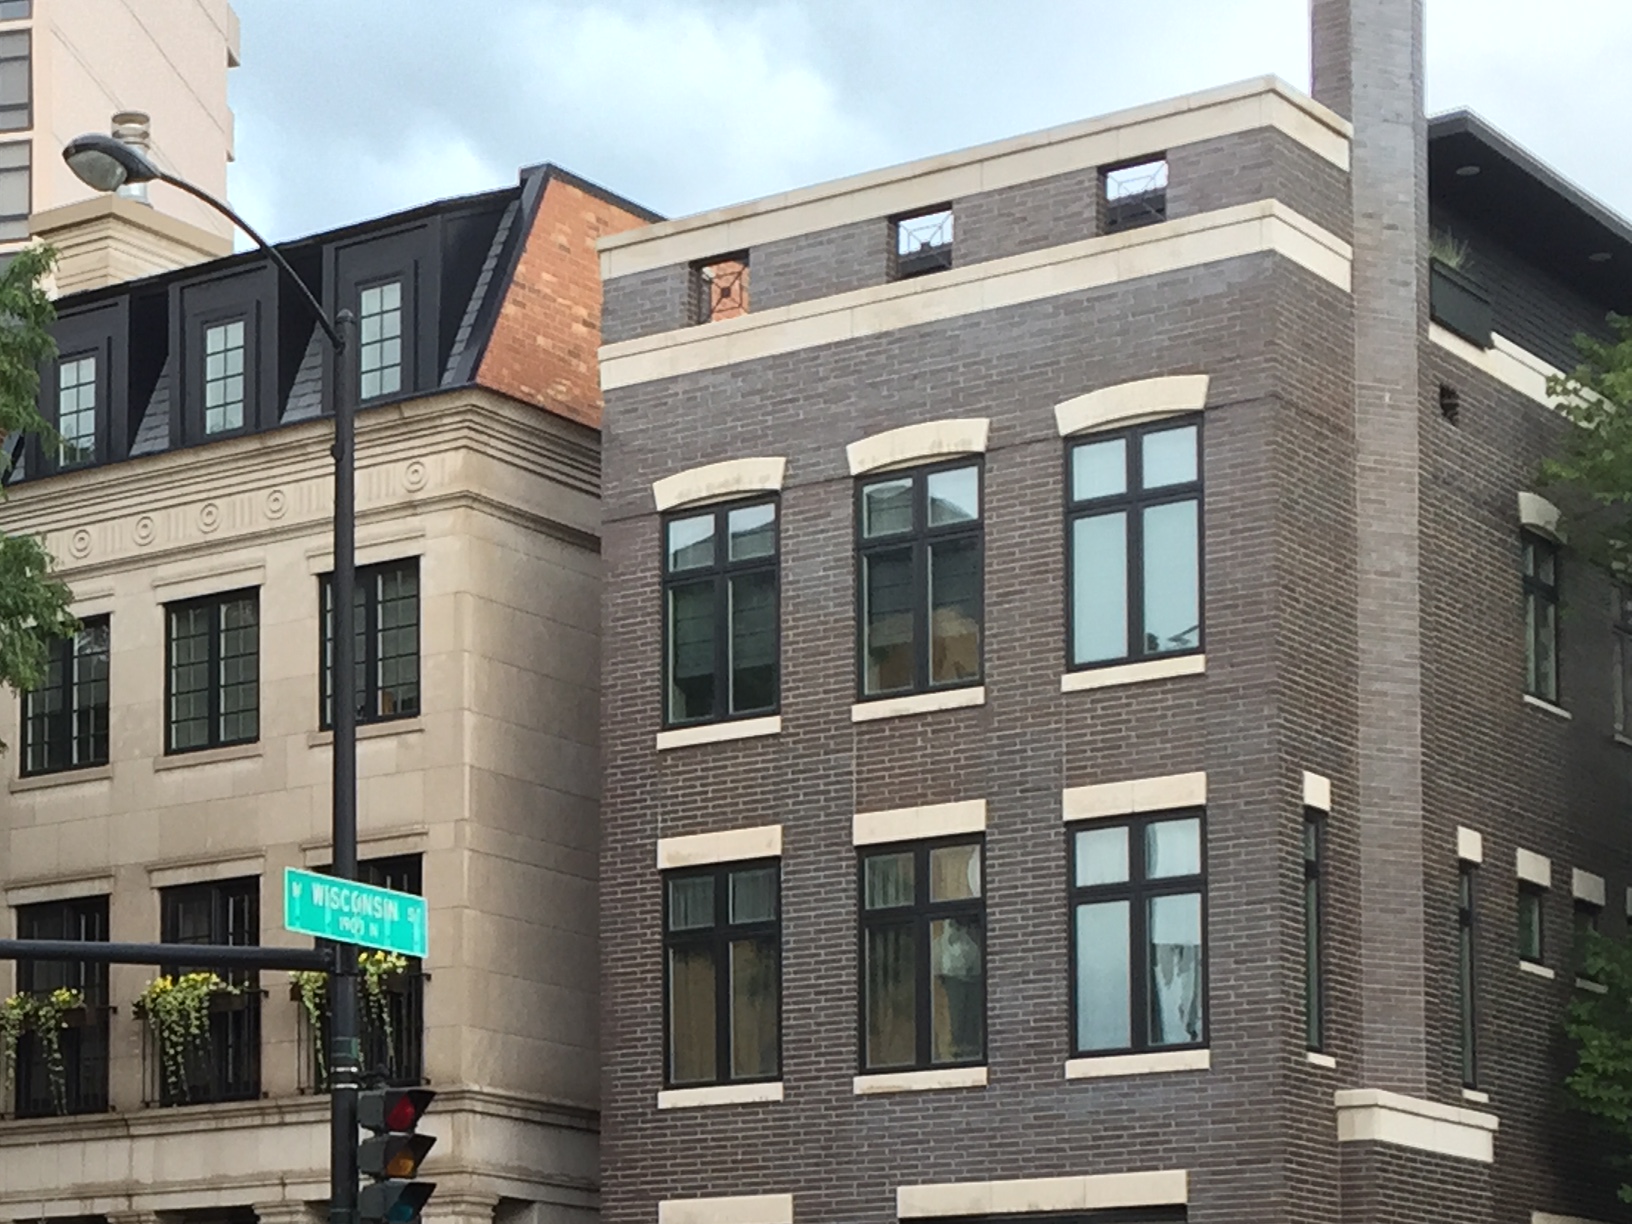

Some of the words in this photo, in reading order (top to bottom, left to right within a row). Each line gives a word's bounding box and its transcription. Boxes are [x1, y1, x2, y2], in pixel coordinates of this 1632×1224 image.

[291, 881, 303, 898] W
[311, 881, 399, 921] WISCONSIN
[407, 905, 422, 924] ST
